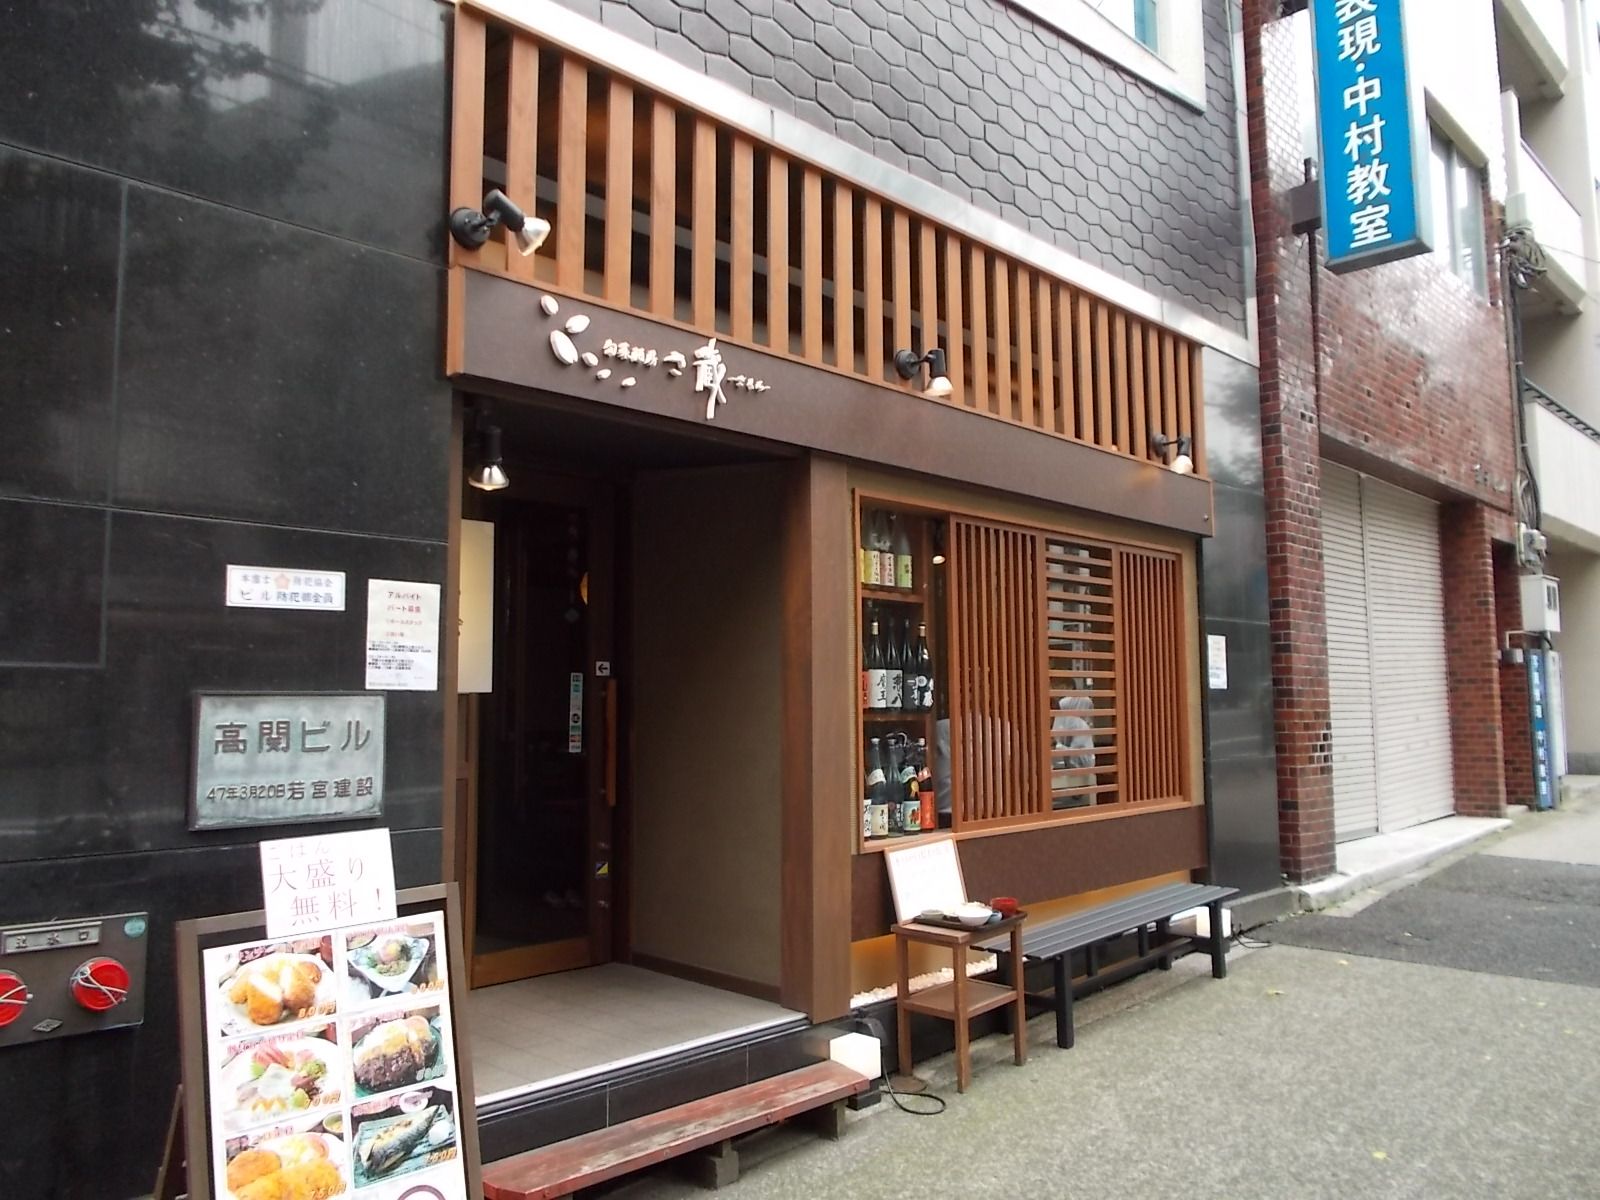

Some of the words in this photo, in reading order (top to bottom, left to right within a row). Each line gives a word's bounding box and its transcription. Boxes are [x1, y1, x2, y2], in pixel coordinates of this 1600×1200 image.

[214, 721, 370, 754] 高関ビル
[268, 856, 364, 894] 大盛り
